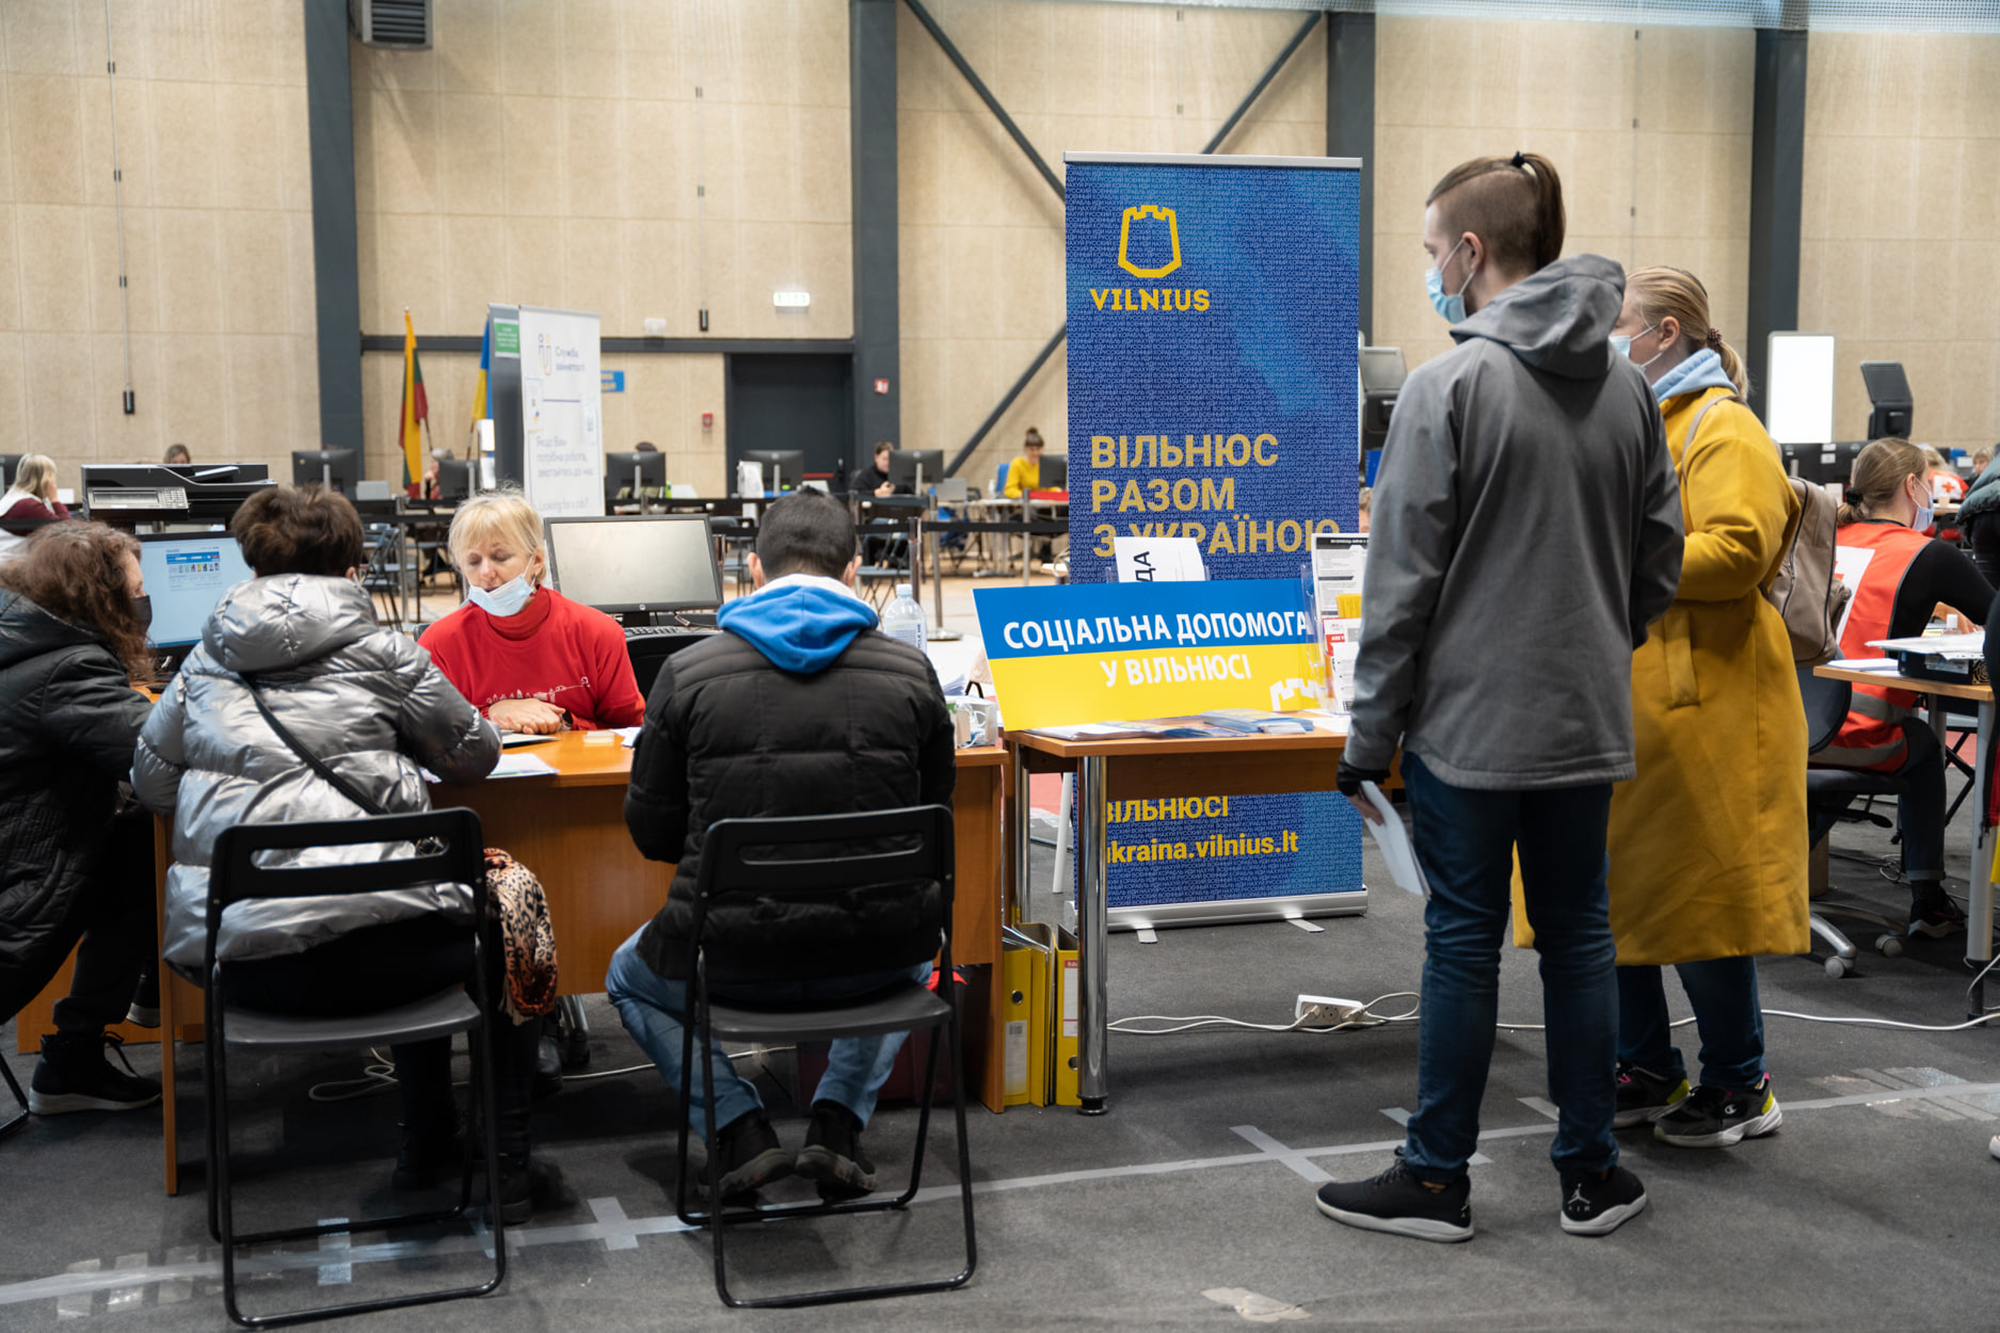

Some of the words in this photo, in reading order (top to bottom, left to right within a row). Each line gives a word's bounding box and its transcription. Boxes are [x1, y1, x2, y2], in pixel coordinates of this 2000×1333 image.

[1090, 288, 1209, 311] VILNIUS
[1092, 434, 1278, 468] ВІЛЬНЮС
[1092, 478, 1234, 513] РАЗОМ
[1004, 614, 1172, 651] СОЦІАЛЬНА
[1176, 611, 1314, 645] ДОПОМОГА
[1100, 661, 1117, 687] У
[1125, 654, 1251, 685] ВІЛЬНЮСІ
